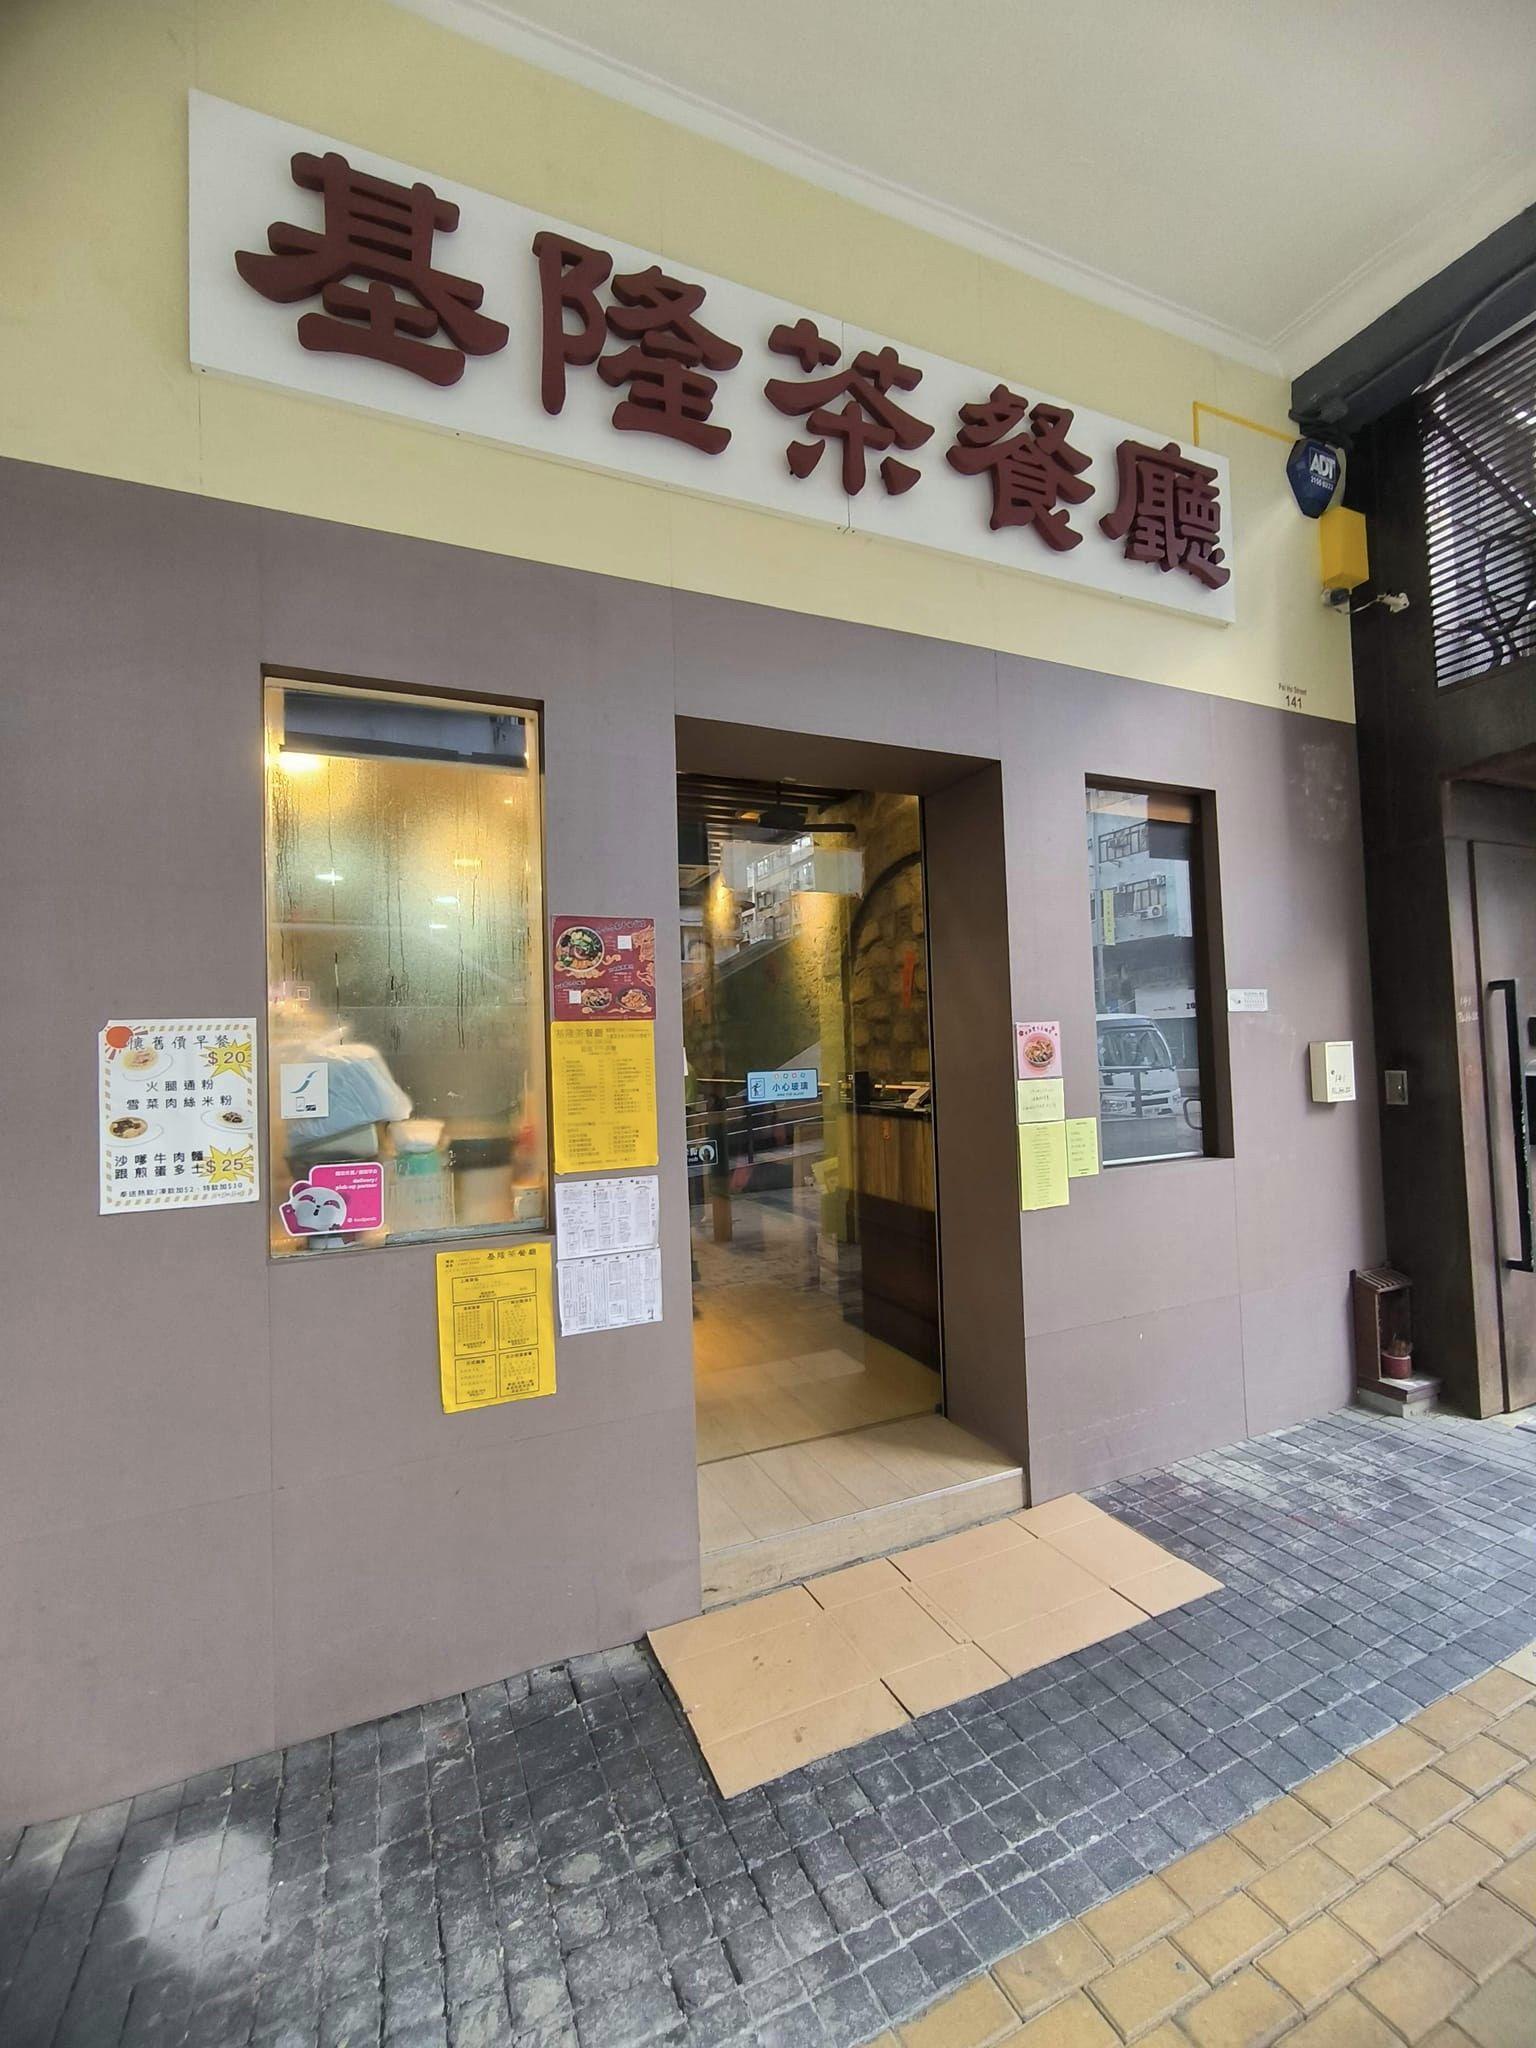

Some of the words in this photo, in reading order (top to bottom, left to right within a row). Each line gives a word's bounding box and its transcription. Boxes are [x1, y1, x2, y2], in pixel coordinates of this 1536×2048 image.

[234, 150, 1232, 590] 基隆茶餐廳
[1310, 452, 1336, 479] ADT
[1285, 694, 1302, 709] 141
[146, 1079, 214, 1093] 火腿通粉
[772, 1081, 809, 1093] 小心玻璃
[126, 1095, 233, 1111] 雪菜肉絲米粉
[114, 1163, 204, 1180] 跟煎蛋多士
